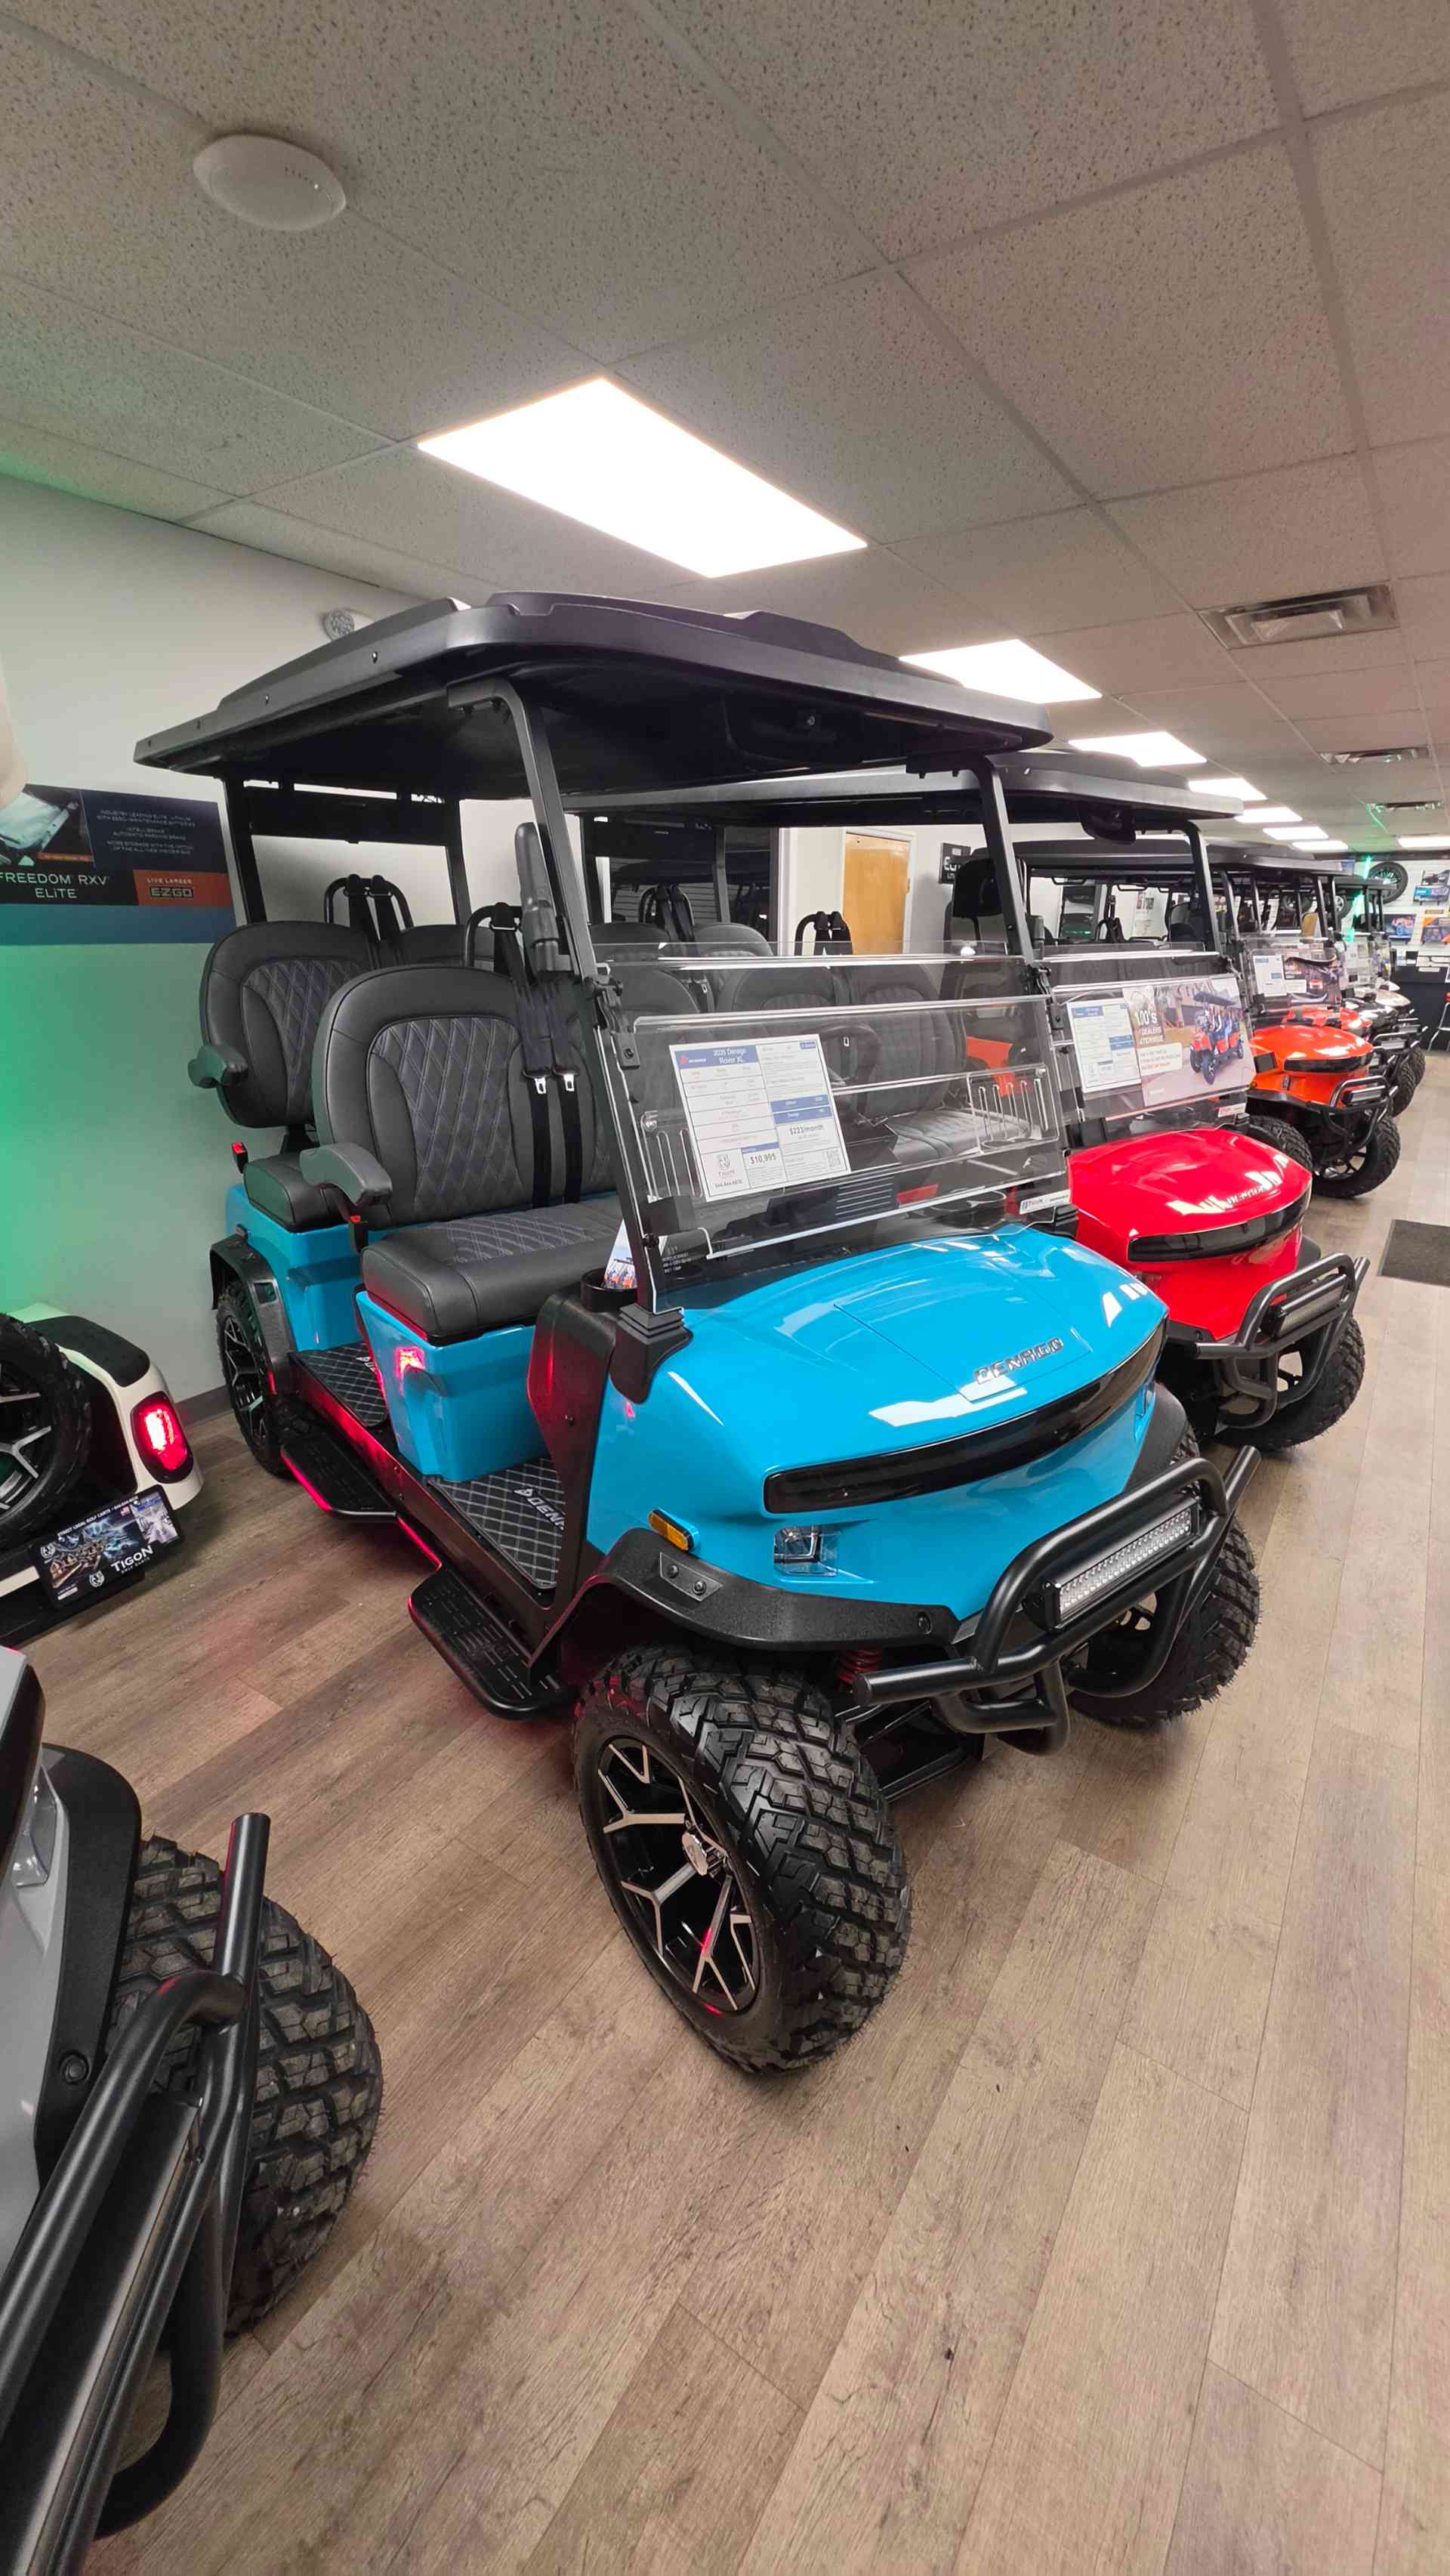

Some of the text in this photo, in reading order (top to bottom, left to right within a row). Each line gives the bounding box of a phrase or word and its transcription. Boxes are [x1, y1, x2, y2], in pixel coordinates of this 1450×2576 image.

[78, 874, 107, 885] RXV
[974, 1337, 1064, 1385] DENAGO
[111, 1545, 153, 1572] TIGON
